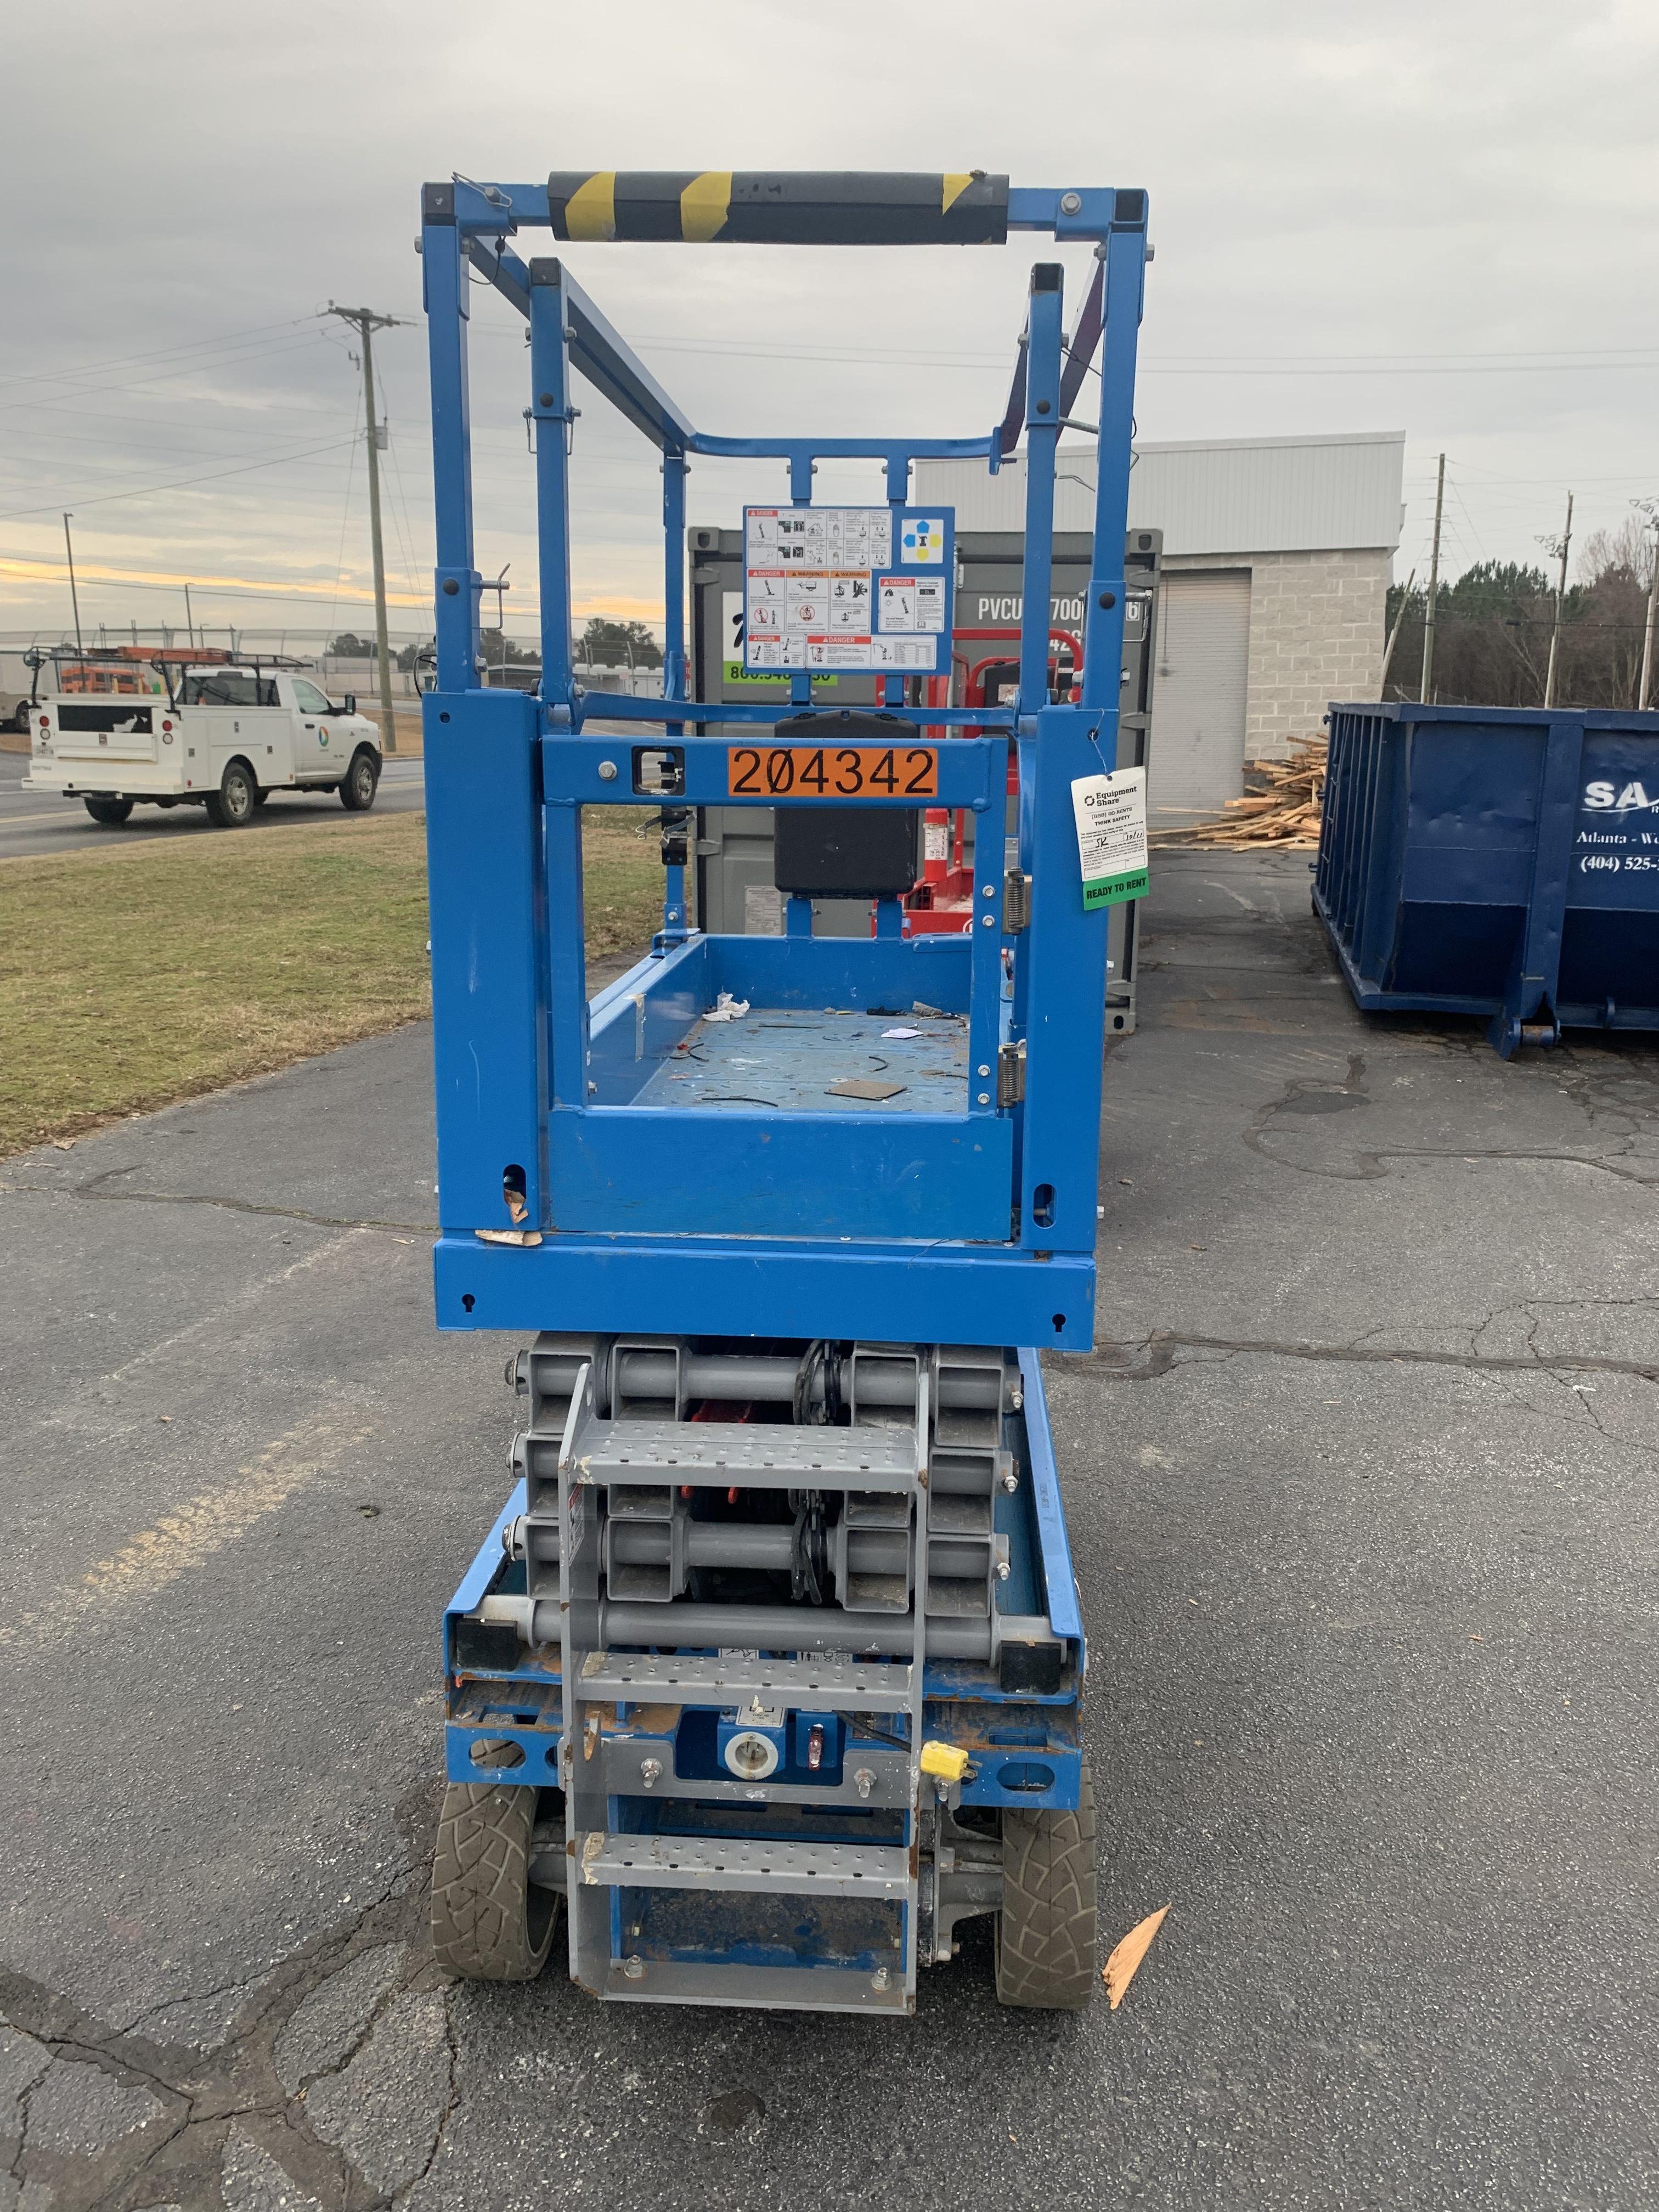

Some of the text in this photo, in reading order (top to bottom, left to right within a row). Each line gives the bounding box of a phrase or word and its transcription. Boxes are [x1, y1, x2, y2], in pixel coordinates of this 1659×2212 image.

[978, 598, 1023, 620] PVCU
[1096, 786, 1137, 799] Equipment
[1584, 781, 1649, 808] SA
[1112, 815, 1130, 823] SAFETY
[1576, 831, 1627, 844] Atlanta
[1581, 856, 1659, 873] (404) 525-
[1087, 877, 1147, 899] READY TO RENT
